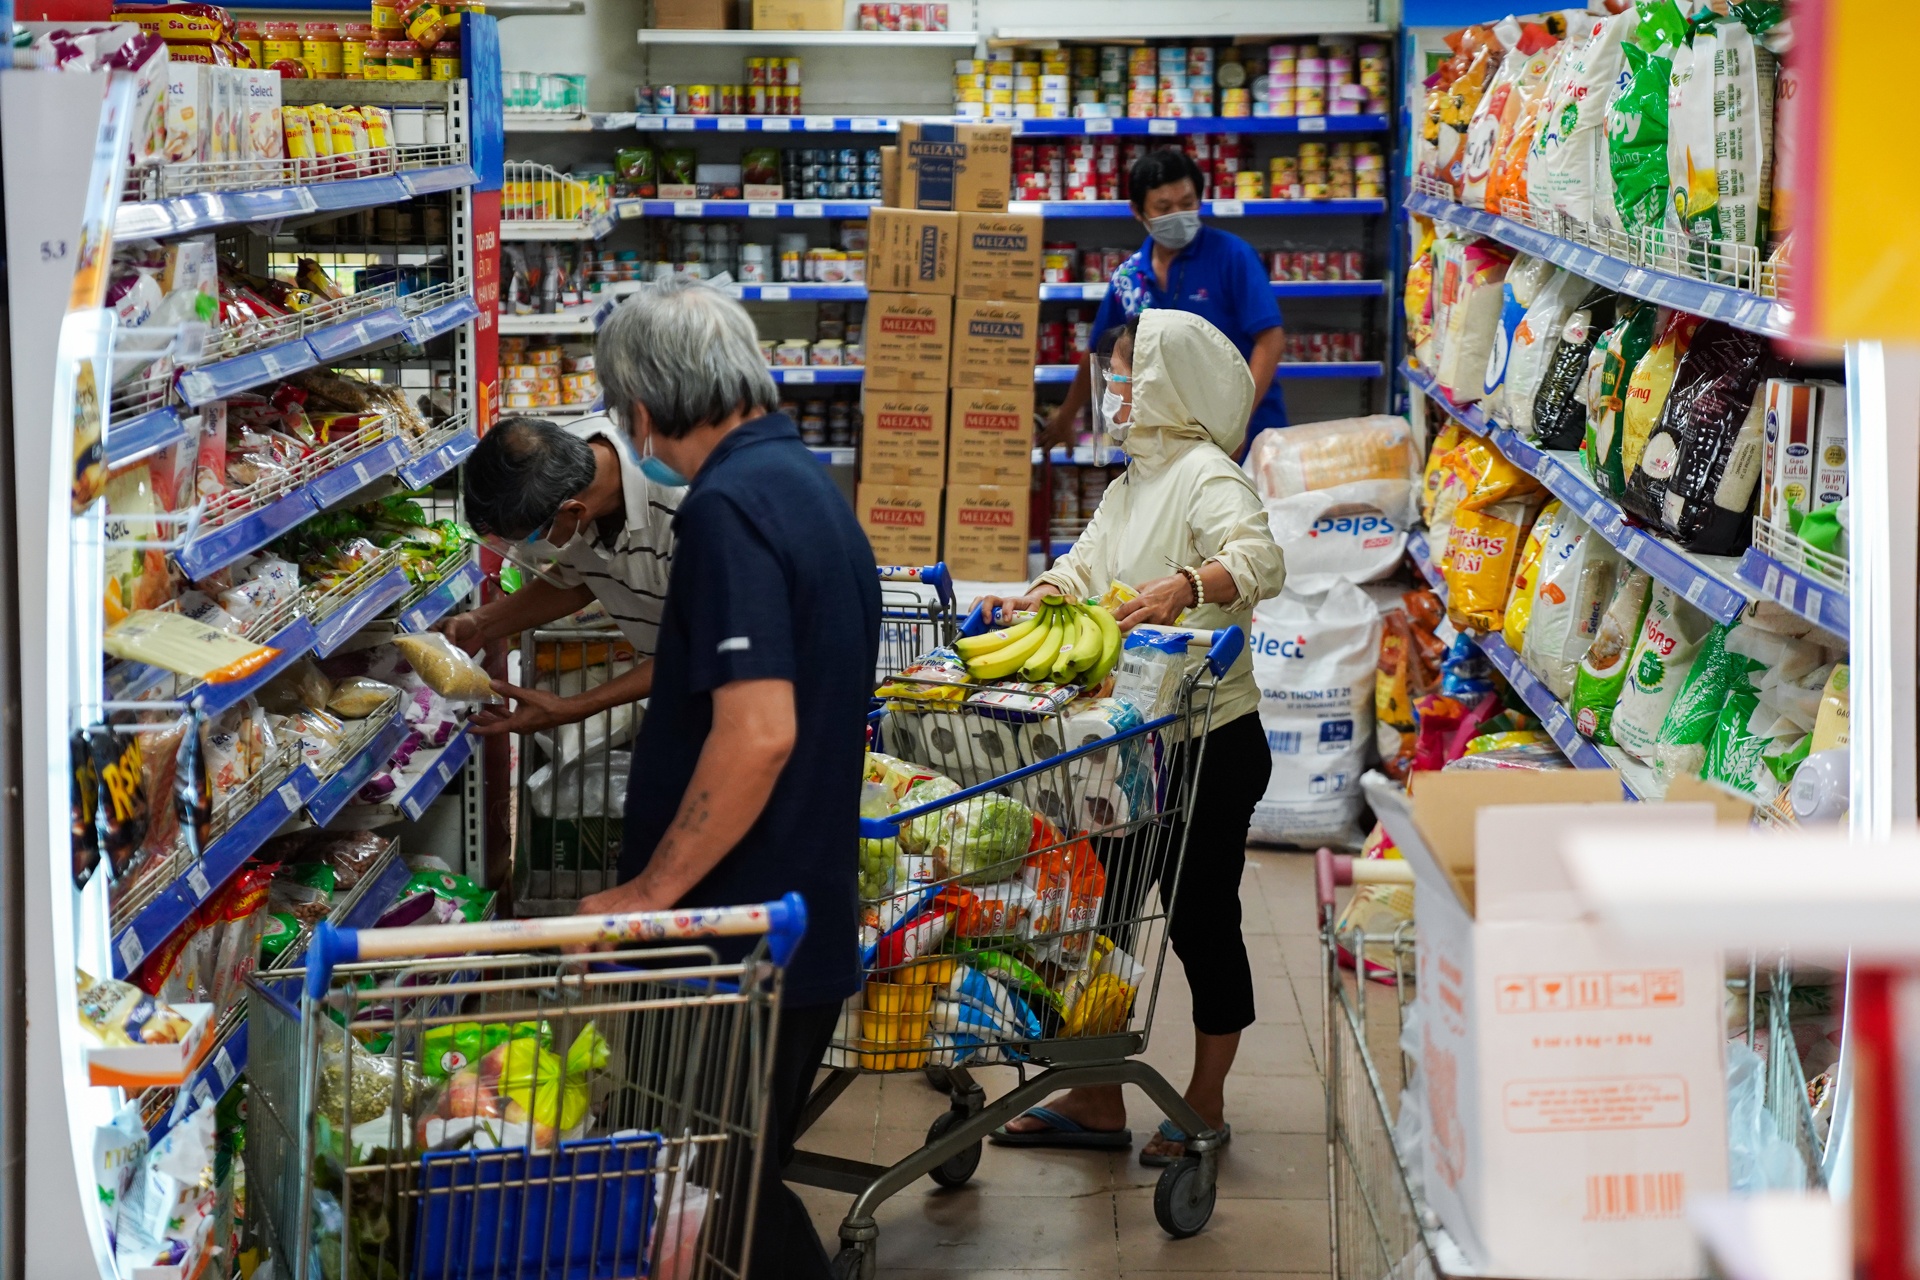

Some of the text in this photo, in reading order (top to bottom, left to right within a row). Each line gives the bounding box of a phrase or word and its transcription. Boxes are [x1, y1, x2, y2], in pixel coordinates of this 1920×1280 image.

[168, 20, 184, 30] Sa
[250, 82, 273, 98] Select
[1714, 90, 1726, 117] 100%
[911, 144, 964, 156] MEIZAN
[1715, 131, 1728, 160] 100%
[1717, 169, 1729, 197] 100%
[974, 236, 1025, 249] MEIZAN
[921, 228, 934, 279] MEIZAN
[882, 319, 934, 332] MEIZAN
[971, 322, 1022, 335] MEIZAN
[880, 416, 931, 429] MEIZAN
[966, 415, 1017, 428] MEIZAN
[872, 510, 923, 524] MEIZAN
[960, 511, 1012, 524] MEIZAN
[1308, 516, 1395, 538] Select
[1290, 689, 1324, 701] THƠM
[1326, 688, 1338, 699] ST
